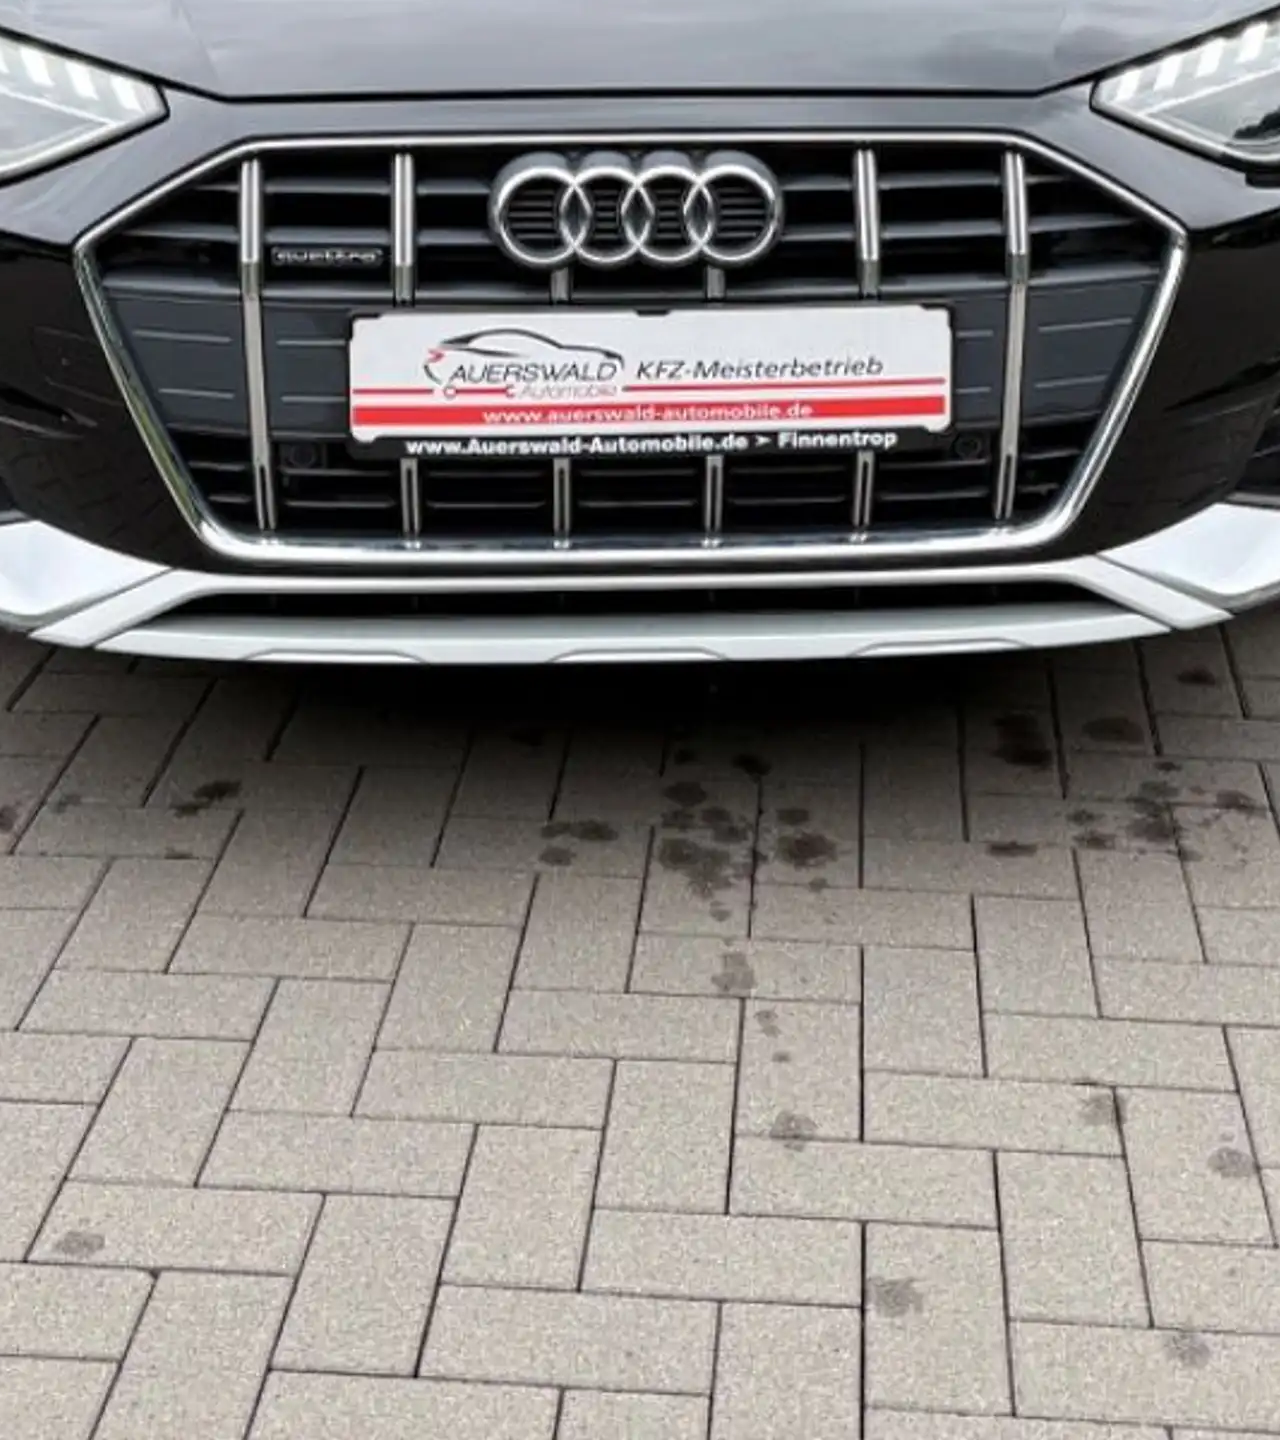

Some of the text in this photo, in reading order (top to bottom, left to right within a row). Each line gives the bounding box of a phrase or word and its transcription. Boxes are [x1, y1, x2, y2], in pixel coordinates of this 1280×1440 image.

[448, 361, 619, 385] AUERSWALD
[635, 356, 884, 380] KFZ-Meisterbetrieb
[481, 402, 814, 425] www.auerswald-automobile.de
[405, 429, 898, 456] www.Auerswald-Automobile.de Finnentrop
